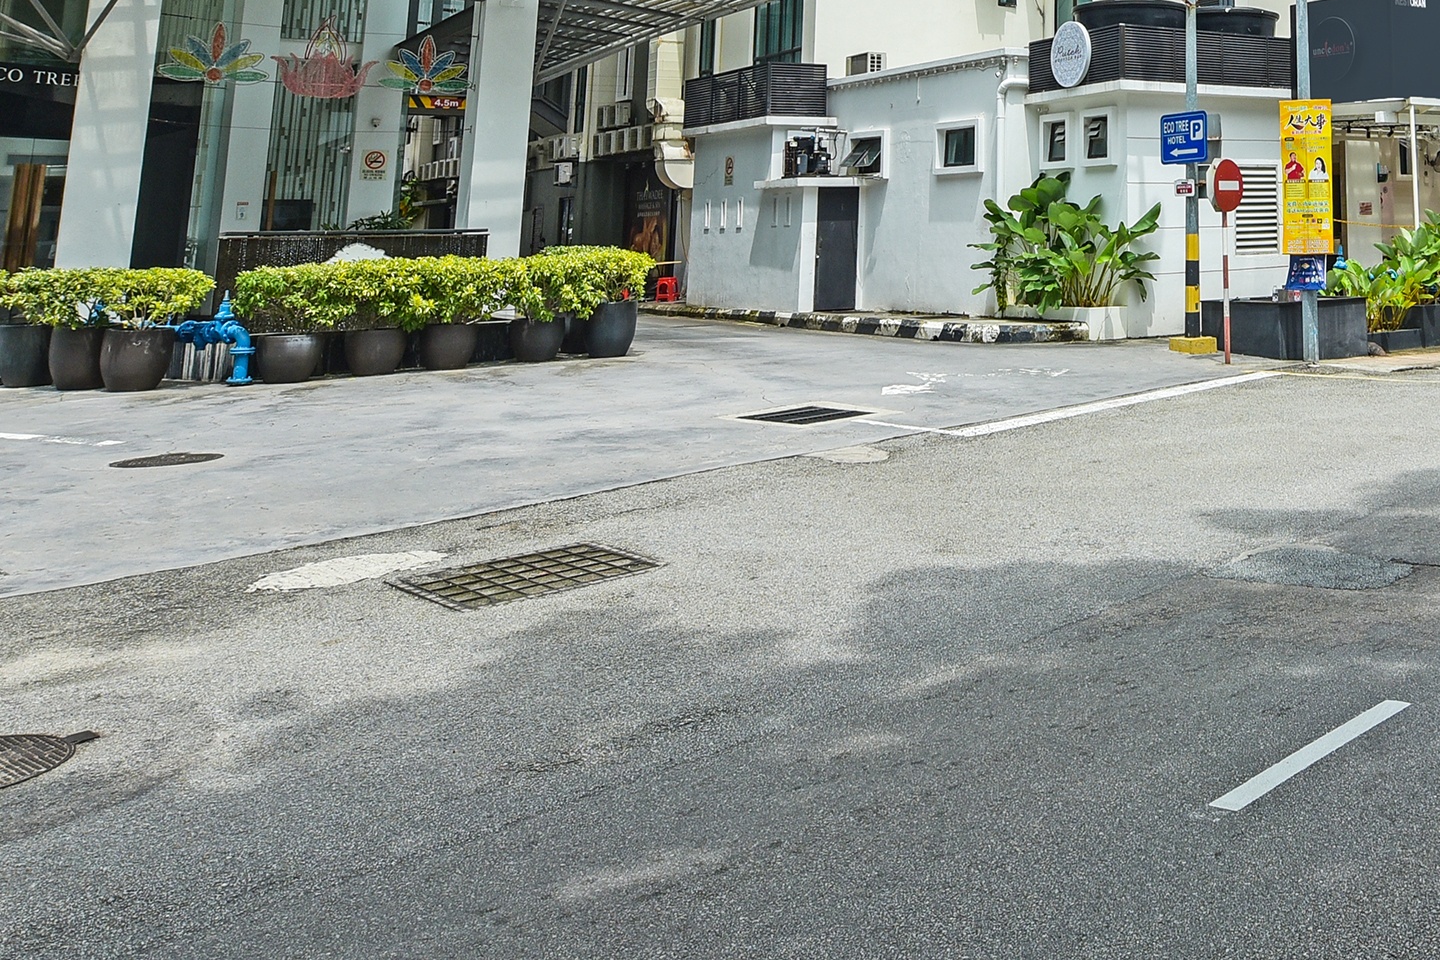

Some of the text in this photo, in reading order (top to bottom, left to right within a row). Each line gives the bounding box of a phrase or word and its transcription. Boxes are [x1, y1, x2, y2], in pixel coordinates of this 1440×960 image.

[434, 98, 459, 107] 4.5m
[1163, 119, 1190, 134] ECO TREE
[1167, 135, 1187, 145] HOTEL
